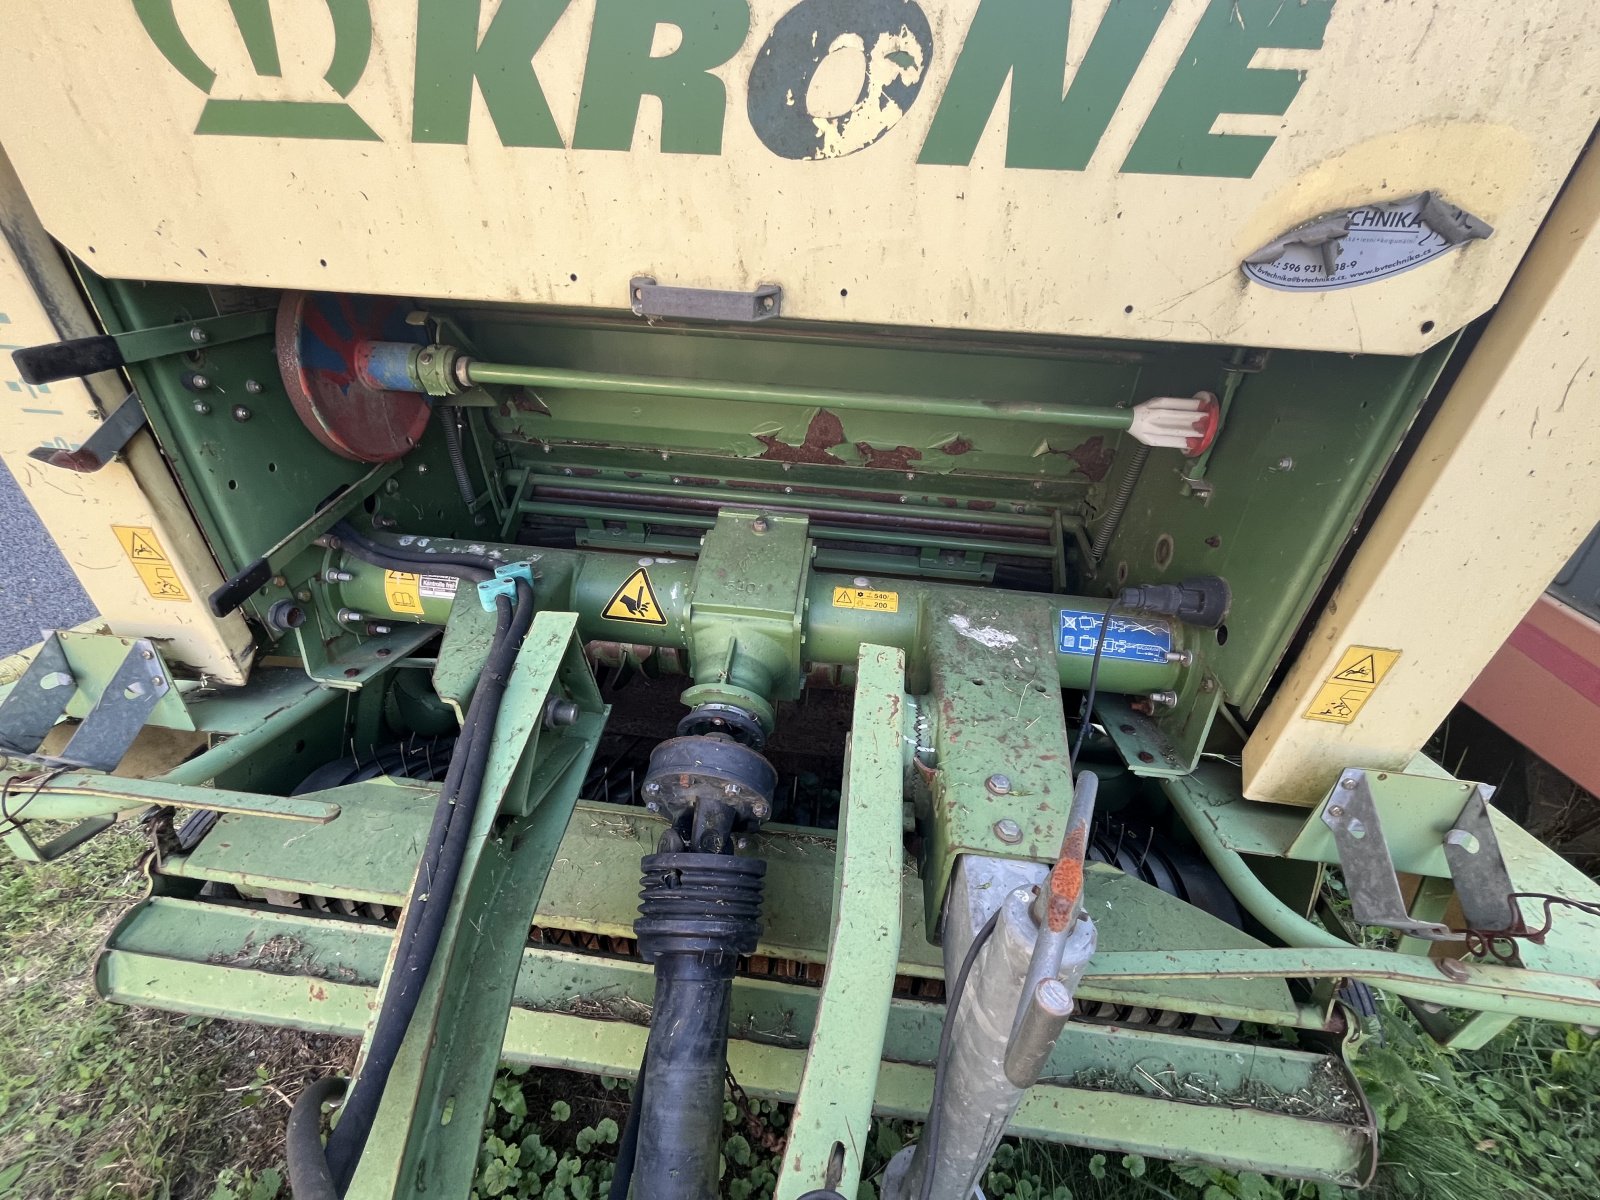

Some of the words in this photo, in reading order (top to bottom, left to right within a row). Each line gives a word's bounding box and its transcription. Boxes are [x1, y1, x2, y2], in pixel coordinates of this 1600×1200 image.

[412, 0, 1336, 178] KRONE
[1282, 262, 1301, 273] 596
[1304, 264, 1322, 273] 931
[1350, 248, 1432, 278] www.bvtechnika.cz
[874, 601, 888, 609] 200
